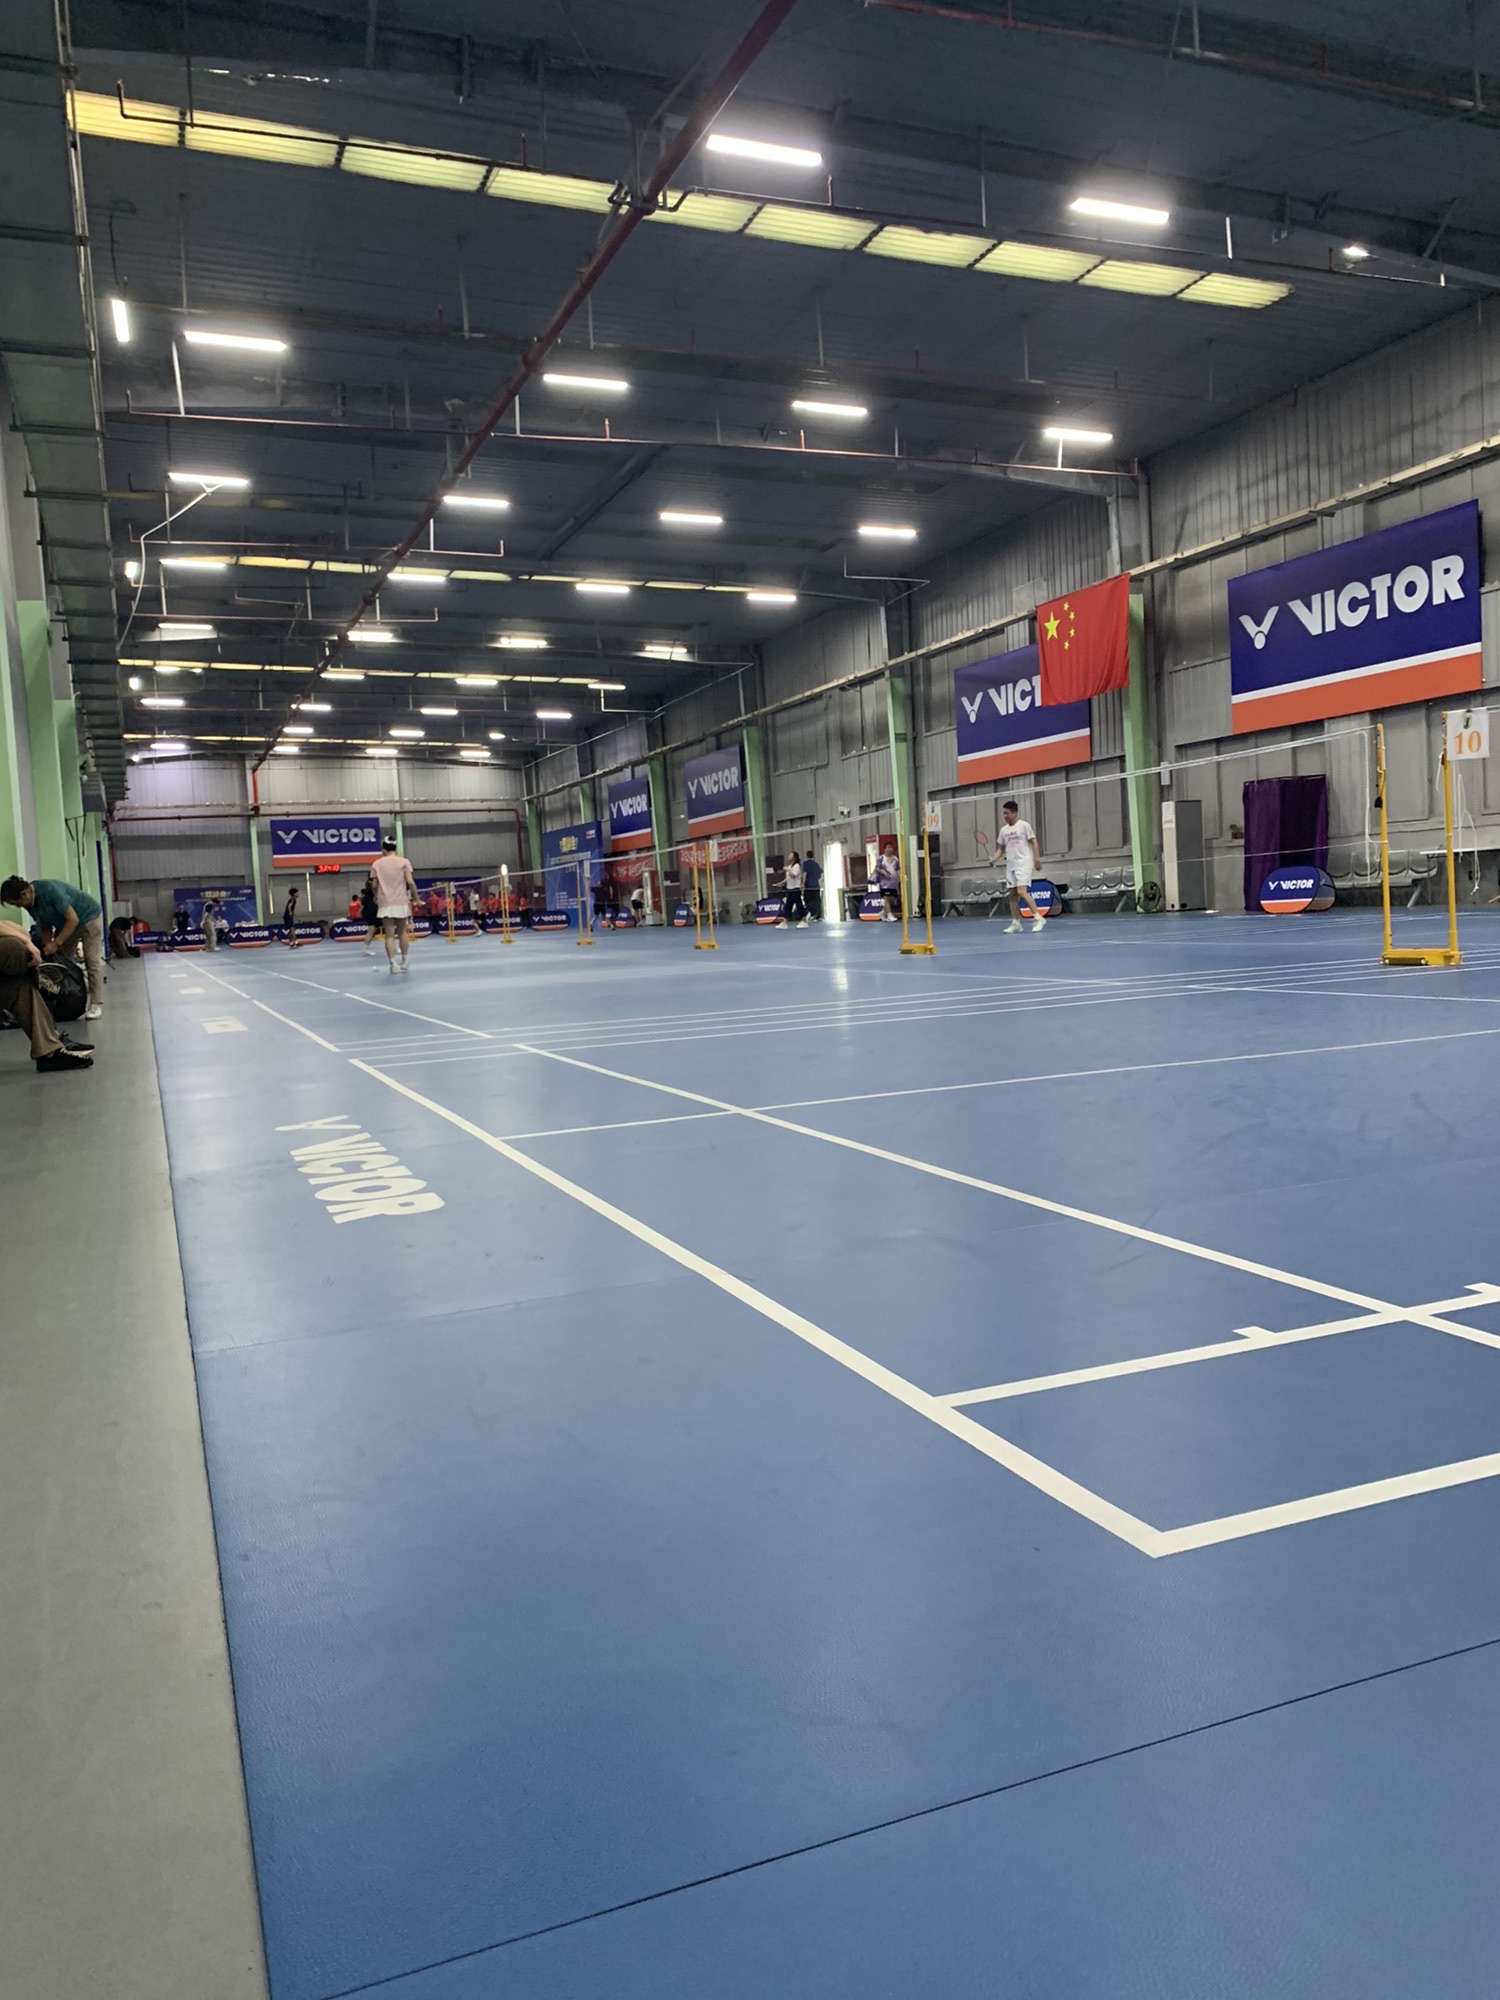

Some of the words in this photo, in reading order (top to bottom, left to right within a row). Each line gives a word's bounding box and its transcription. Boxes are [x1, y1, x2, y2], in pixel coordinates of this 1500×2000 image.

[1287, 554, 1465, 636] VICTOR
[987, 674, 1042, 716] VICT
[1455, 730, 1482, 755] 10
[699, 766, 739, 796] VICTOR
[619, 793, 648, 817] VICTOR
[927, 814, 939, 828] 09
[302, 827, 377, 845] VICTOR
[1280, 877, 1314, 890] VICTOR
[541, 914, 567, 922] VICTOR
[240, 930, 269, 938] VICTOR
[295, 927, 321, 935] ICTOR
[344, 925, 369, 933] VICTO
[290, 1132, 446, 1225] VICTOR
